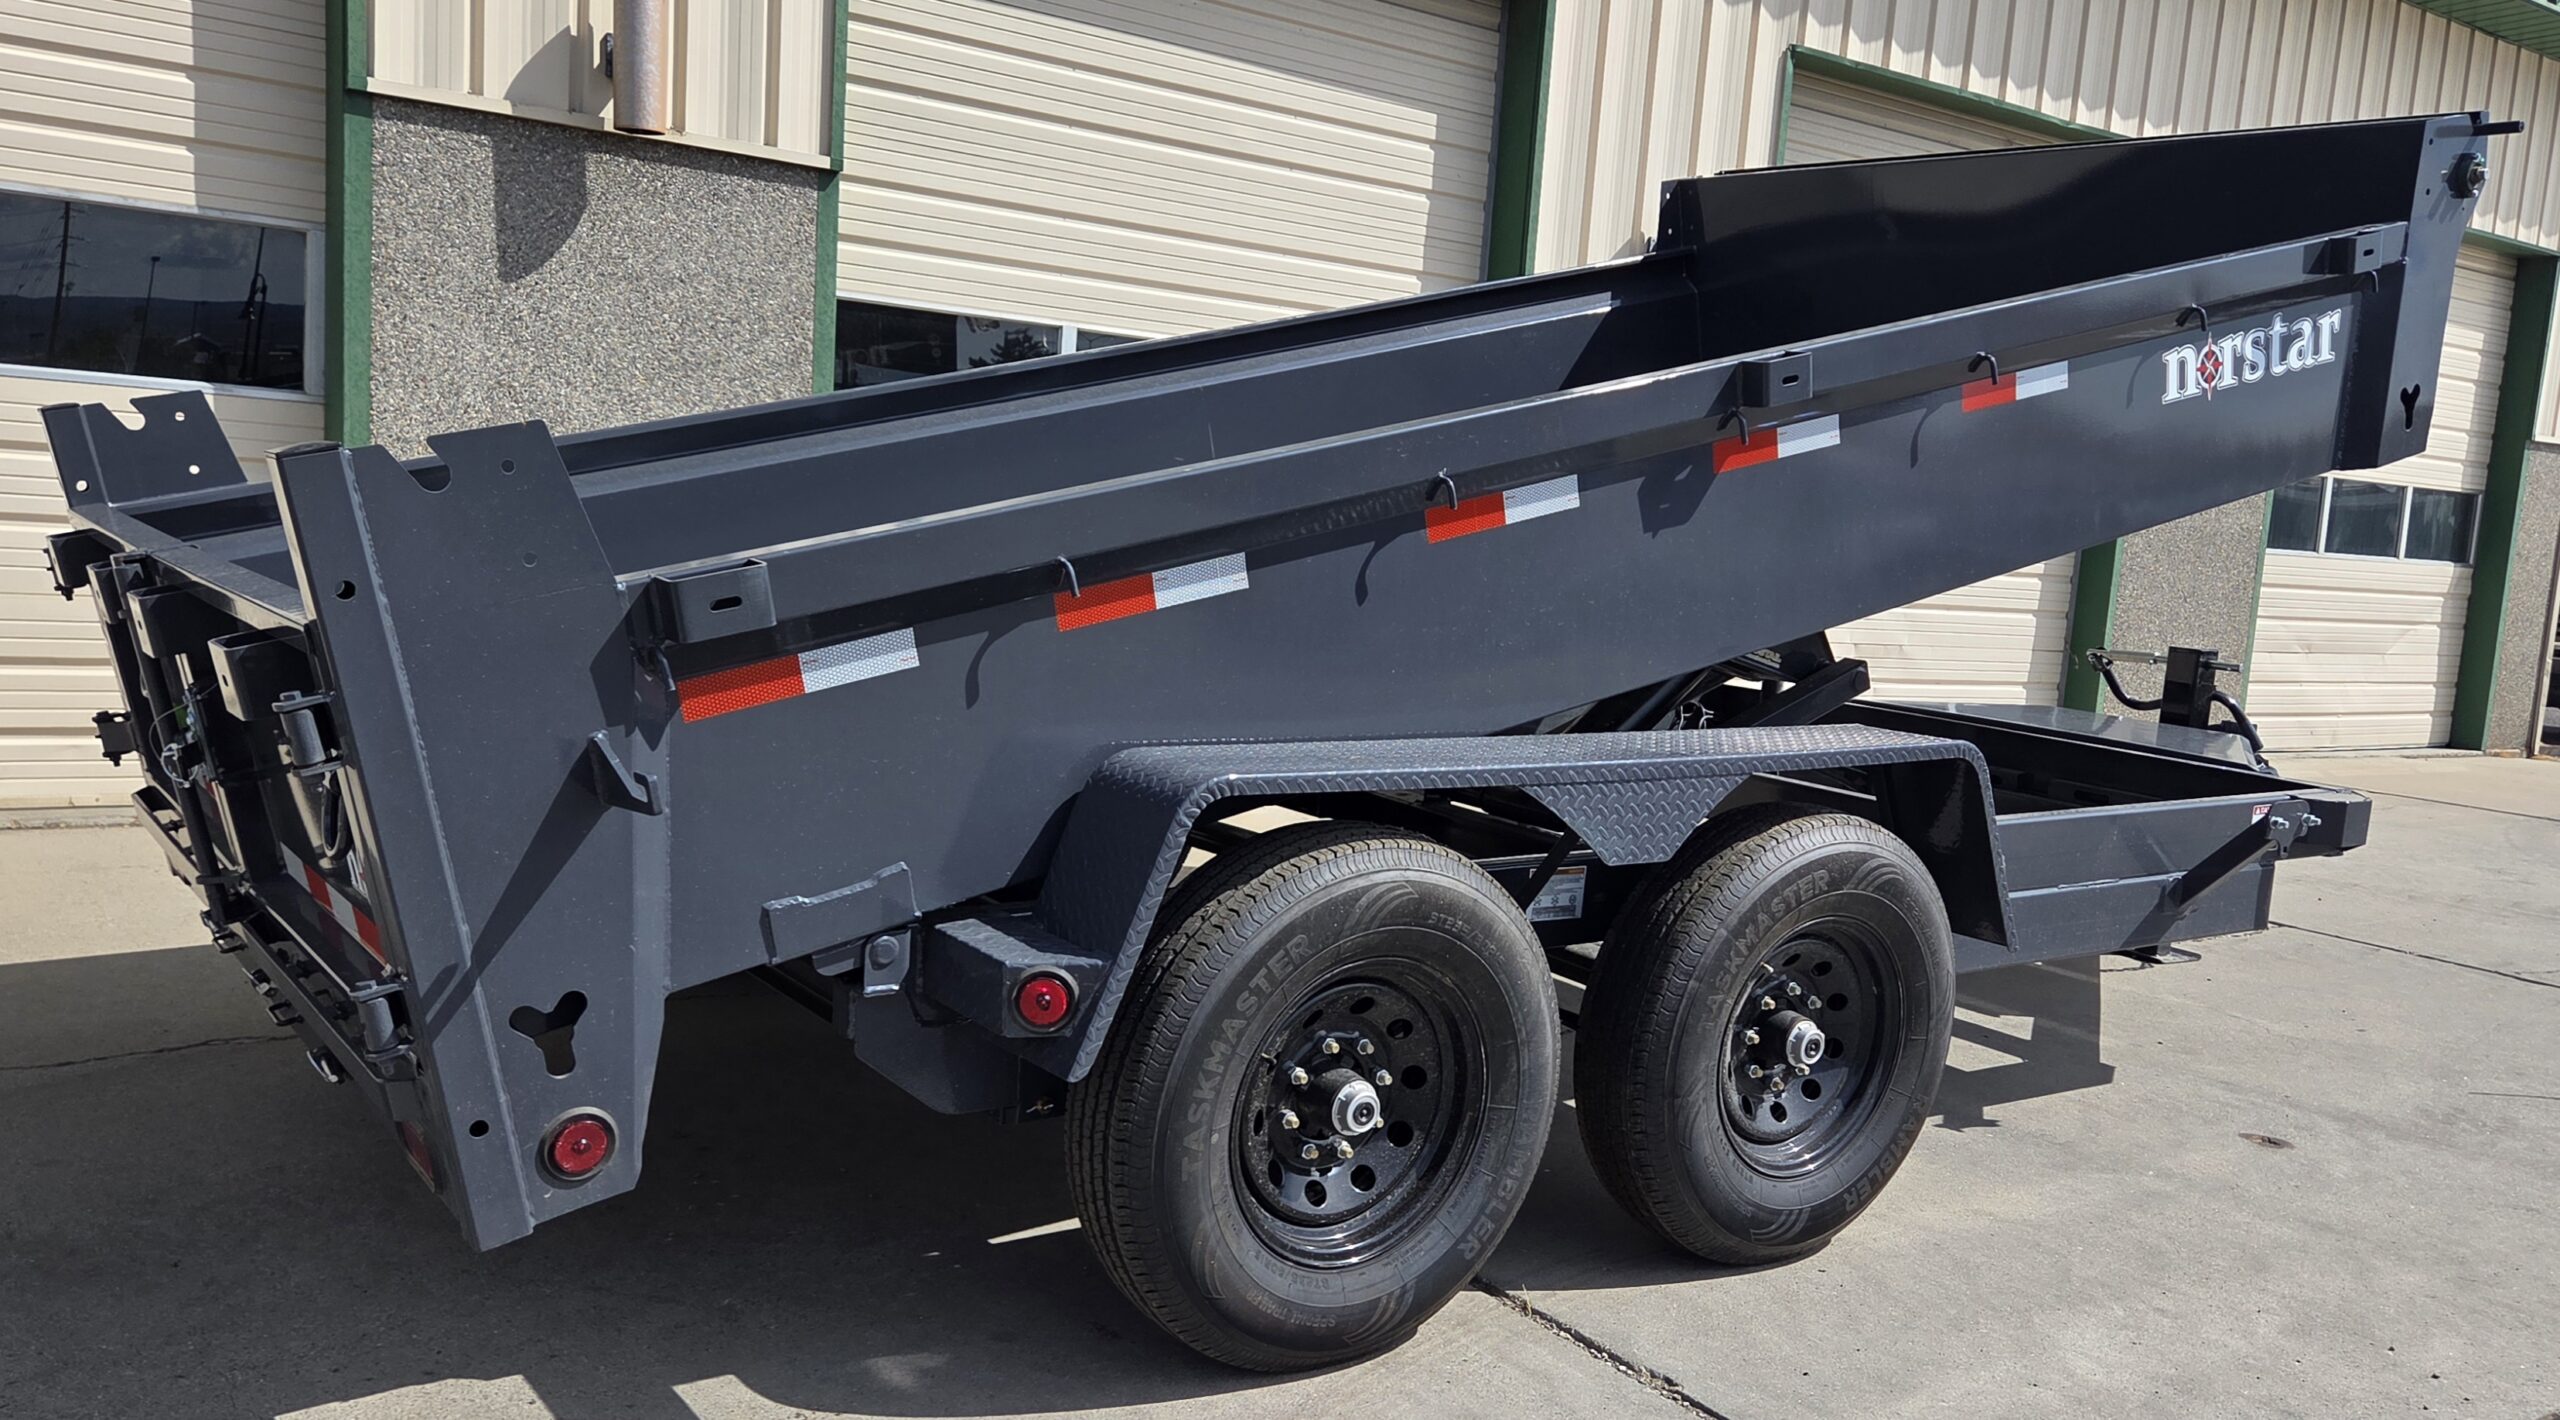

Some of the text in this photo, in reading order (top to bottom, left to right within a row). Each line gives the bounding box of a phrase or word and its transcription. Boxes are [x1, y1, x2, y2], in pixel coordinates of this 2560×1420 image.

[2162, 308, 2342, 405] norstar
[1699, 868, 1831, 1031] TASKMASTER
[1181, 933, 1313, 1183] TASKMASTER
[1843, 1092, 1930, 1213] RAMBLER
